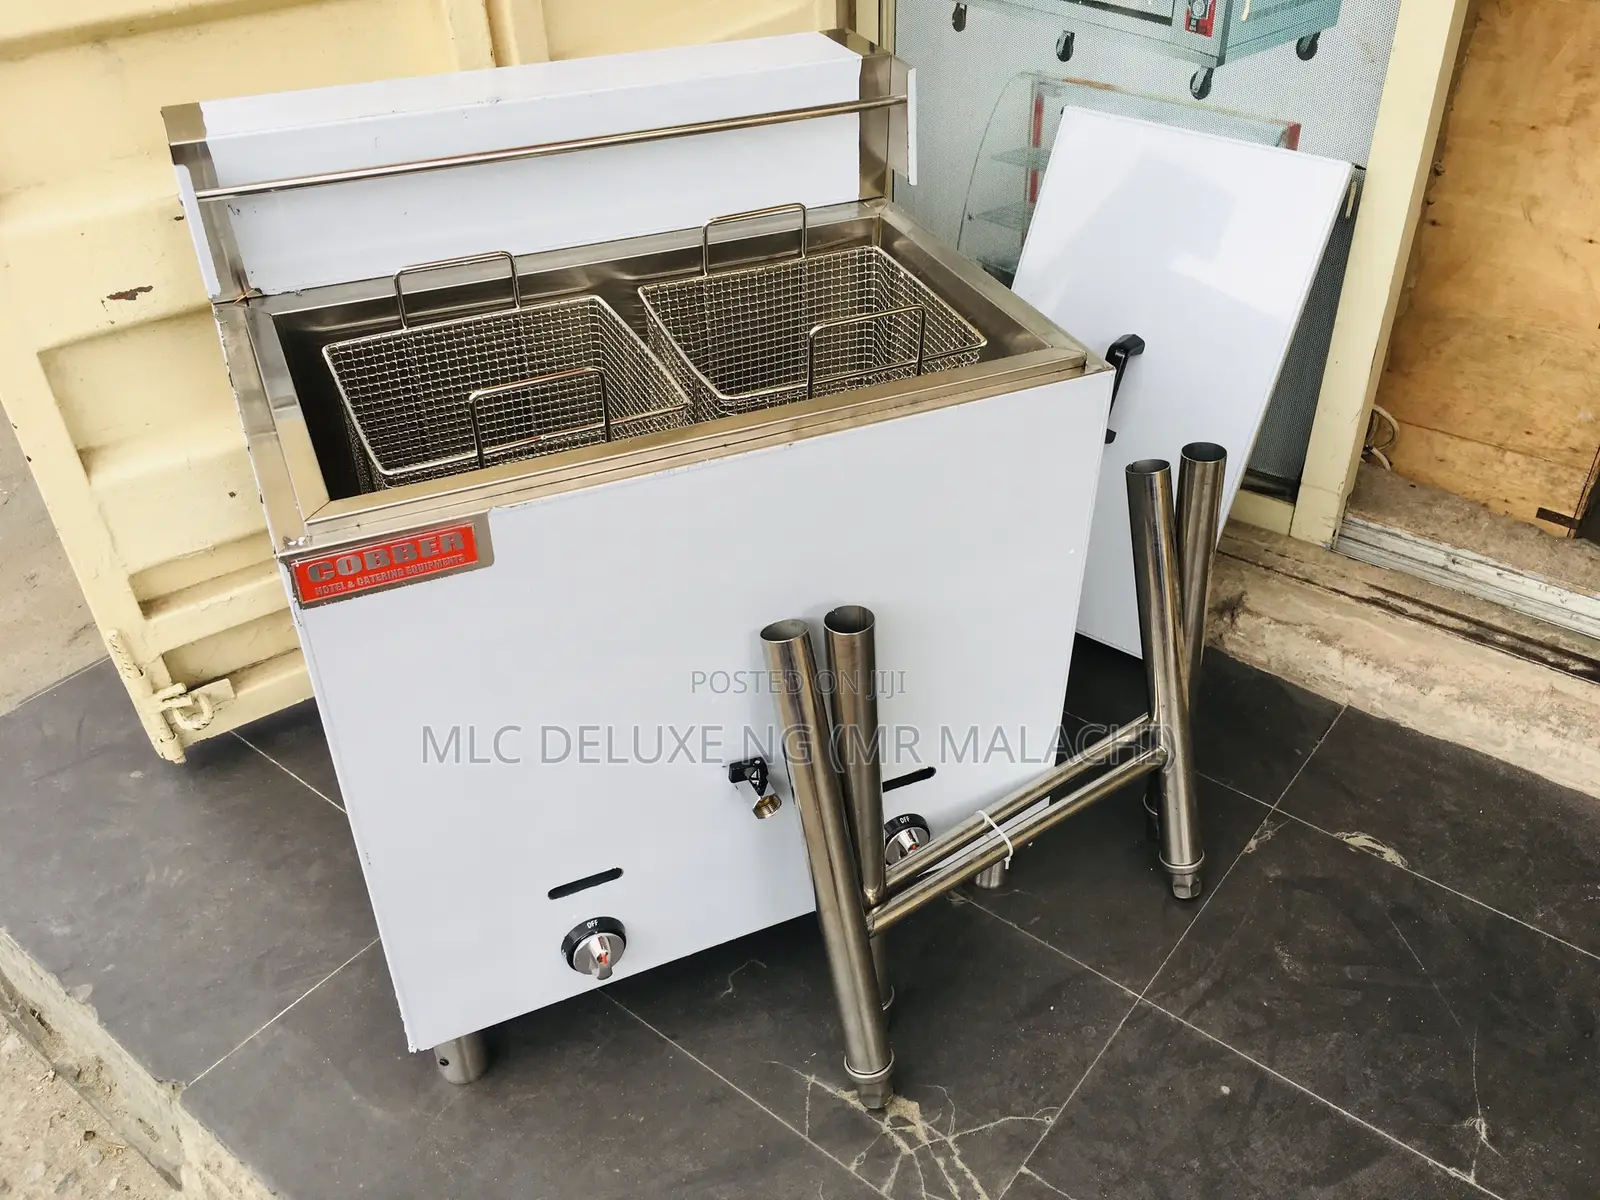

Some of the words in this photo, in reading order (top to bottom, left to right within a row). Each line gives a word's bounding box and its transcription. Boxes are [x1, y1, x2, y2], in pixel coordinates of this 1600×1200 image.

[308, 531, 465, 582] COBBER
[315, 581, 346, 596] HOTEL
[347, 580, 356, 589] &
[356, 569, 404, 588] CATERING
[405, 554, 466, 576] EQUIPMENTS
[899, 815, 910, 824] OFF
[586, 919, 599, 929] OFF
